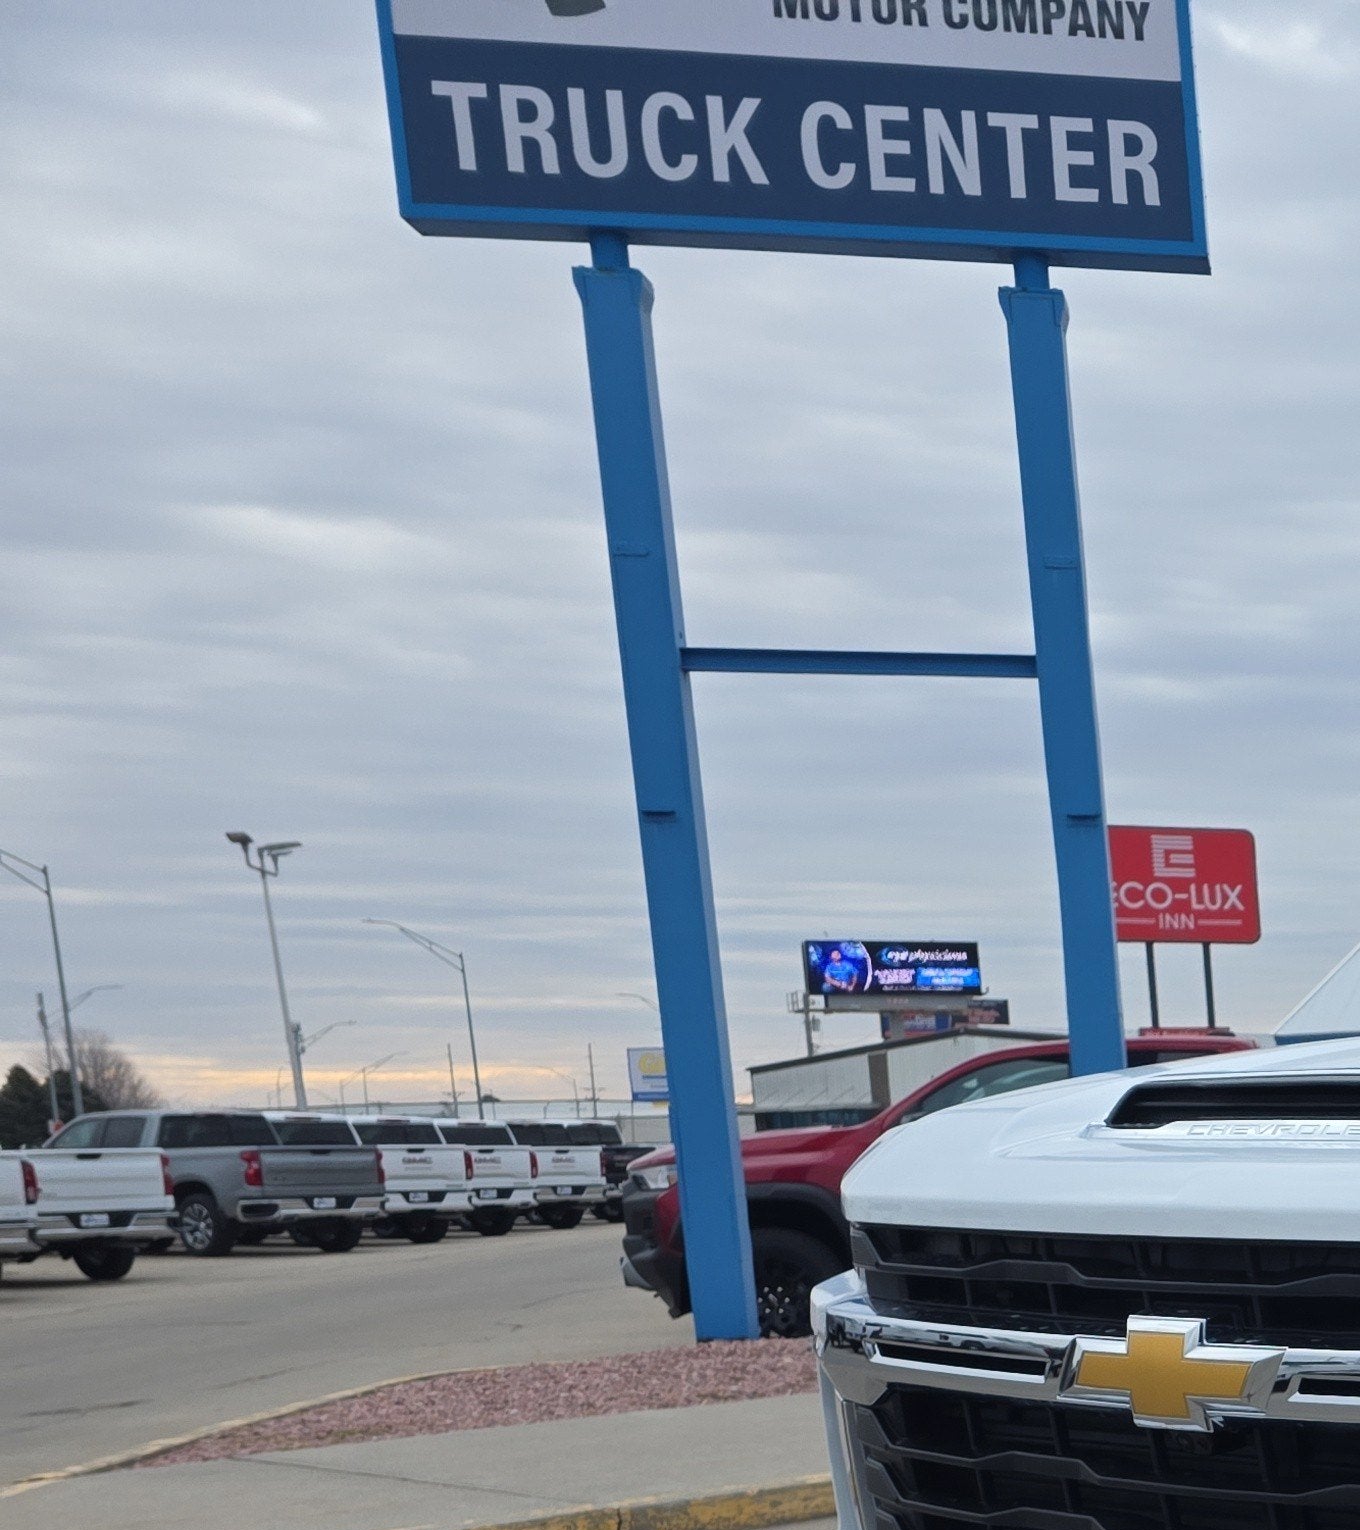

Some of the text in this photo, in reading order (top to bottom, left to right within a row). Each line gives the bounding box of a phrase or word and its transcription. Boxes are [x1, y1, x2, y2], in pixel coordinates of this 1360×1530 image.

[943, 0, 1150, 42] COMPANY
[431, 80, 1162, 208] TRUCK CENTER
[1158, 912, 1195, 930] INN
